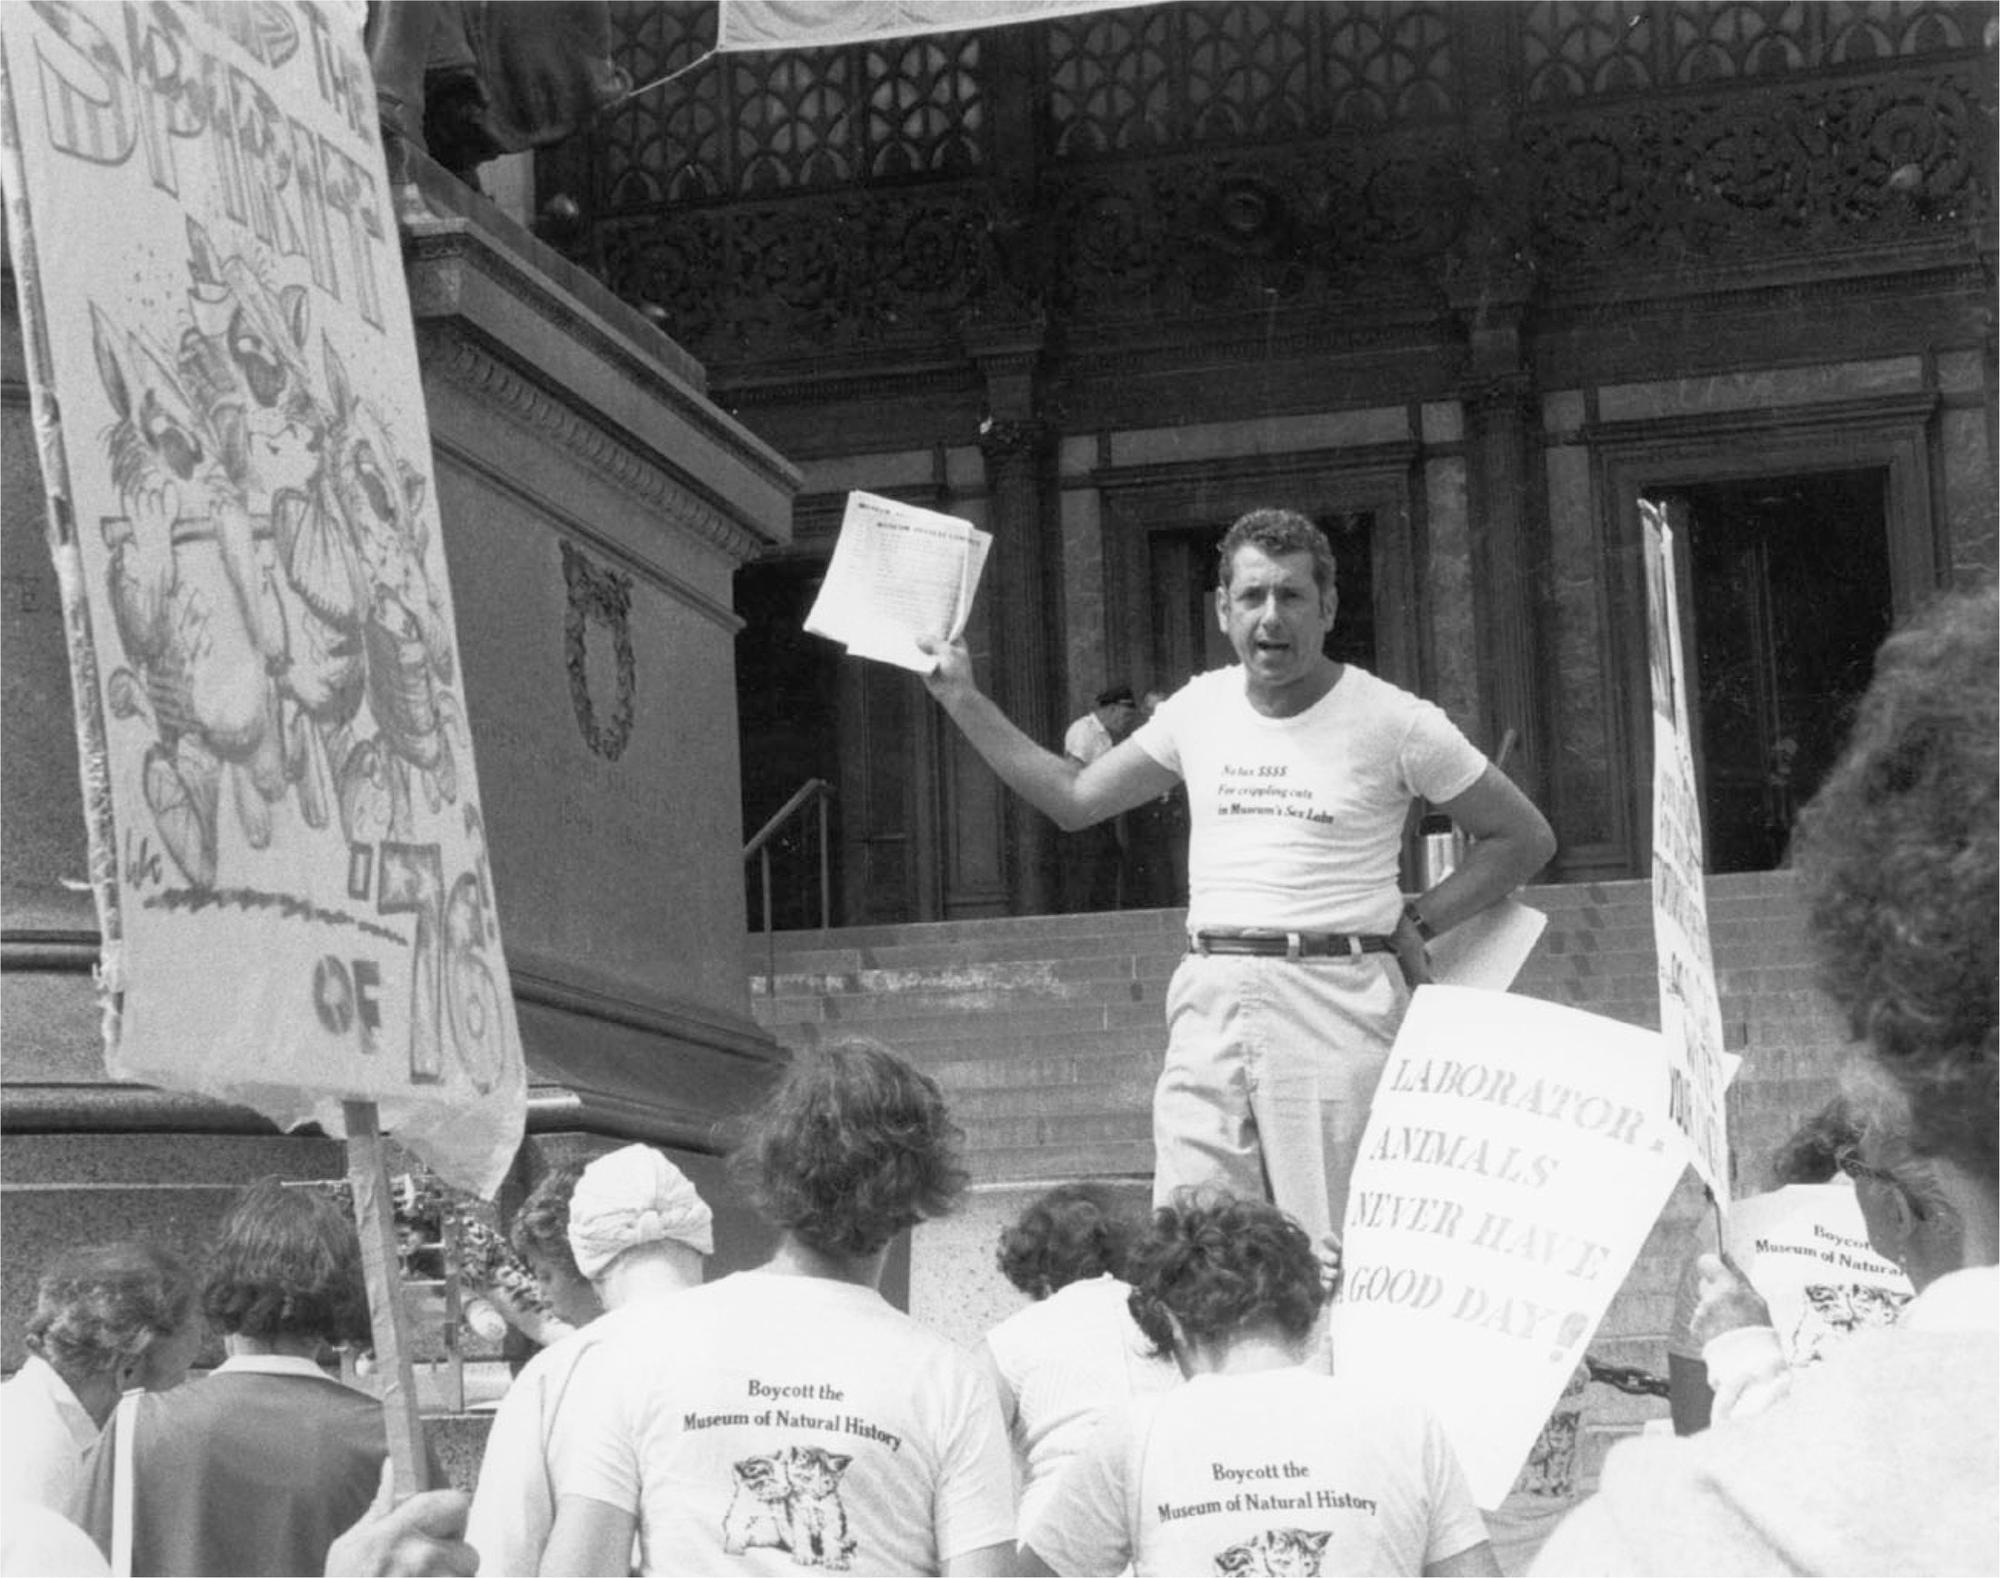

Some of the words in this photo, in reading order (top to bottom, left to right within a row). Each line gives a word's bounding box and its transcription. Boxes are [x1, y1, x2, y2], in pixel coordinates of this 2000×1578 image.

[30, 0, 387, 336] SPIRIT
[1218, 784, 1236, 796] For
[1238, 784, 1288, 798] crippling
[1218, 804, 1228, 815] in
[1230, 802, 1282, 817] Museum's
[1284, 804, 1305, 819] Sex
[312, 954, 382, 1055] OF
[1389, 1058, 1666, 1154] LABORATOR
[1368, 1126, 1561, 1189] ANIMALS
[1350, 1190, 1465, 1239] NEVER
[1469, 1210, 1612, 1282] HAVE
[1755, 1239, 1818, 1258] Museum
[1820, 1251, 1834, 1263] of
[1813, 1223, 1871, 1251] Boycot
[1349, 1264, 1444, 1310] GOOD
[748, 1379, 814, 1401] Boycott
[818, 1383, 845, 1402] the
[683, 1412, 749, 1432] Museum
[754, 1410, 772, 1427] of
[776, 1410, 840, 1432] Natural
[845, 1415, 902, 1453] History
[1212, 1462, 1280, 1484] Boycott
[1283, 1460, 1310, 1479] the
[1158, 1500, 1222, 1523] Museum
[1226, 1494, 1241, 1512] of
[1246, 1491, 1313, 1511] Natural
[1316, 1490, 1377, 1517] History
